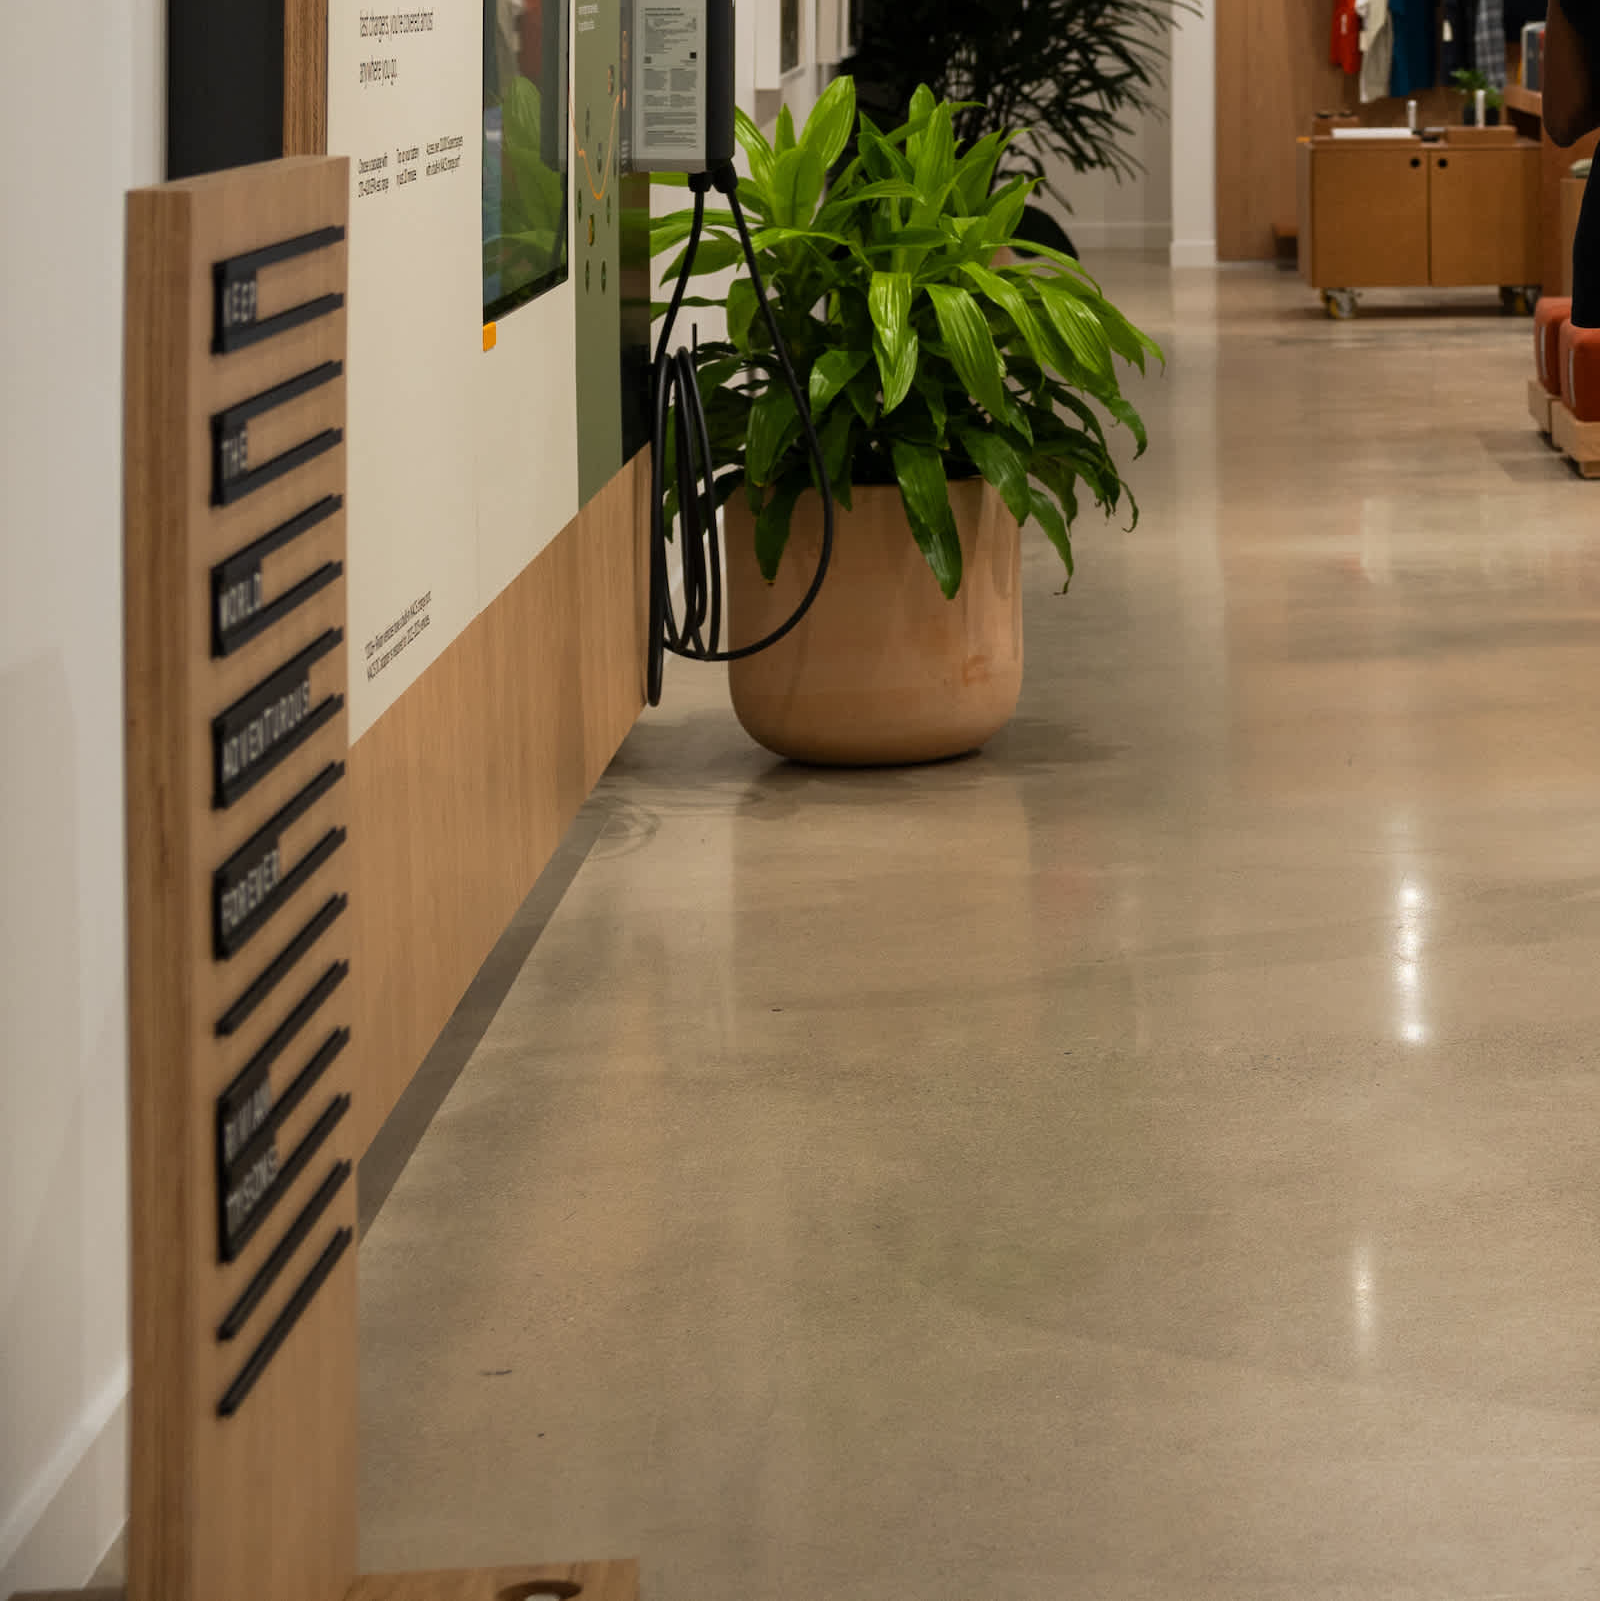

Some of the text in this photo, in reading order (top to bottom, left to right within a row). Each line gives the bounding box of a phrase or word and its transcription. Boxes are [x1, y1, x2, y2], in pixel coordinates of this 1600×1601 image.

[223, 280, 257, 328] KEEP
[222, 430, 248, 480] THE
[220, 572, 263, 631] WORLD
[223, 680, 310, 783] ADVENTUROUS
